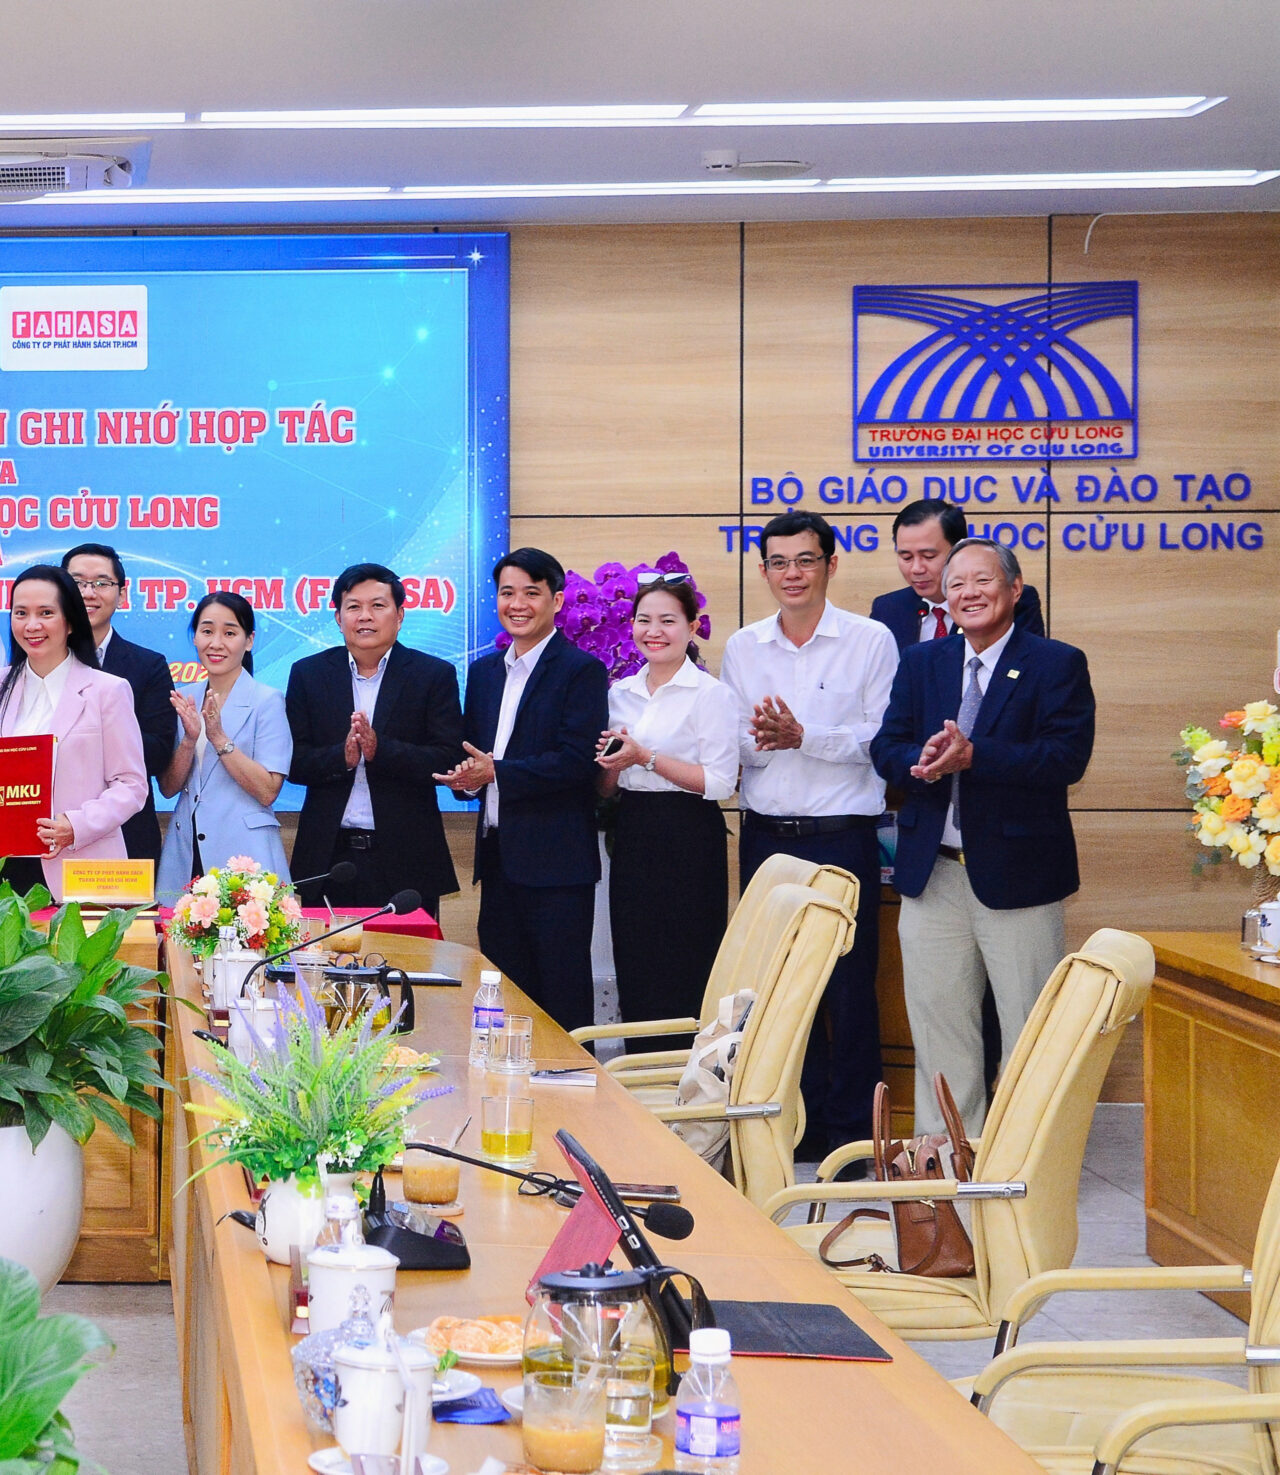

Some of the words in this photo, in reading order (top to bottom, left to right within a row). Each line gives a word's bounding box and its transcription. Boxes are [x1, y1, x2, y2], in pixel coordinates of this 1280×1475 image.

[13, 312, 137, 337] FAHASA
[12, 340, 31, 349] CÔNG
[32, 341, 41, 349] TY
[42, 341, 52, 349] CP
[53, 339, 71, 349] PHÁT
[19, 411, 84, 446] GHI
[97, 402, 180, 445] NHỚ
[189, 409, 267, 452] HỢP
[279, 403, 353, 444] TÁC
[951, 427, 982, 443] ĐẠI
[987, 427, 1024, 443] HỌC
[1075, 425, 1124, 440] LONG
[868, 444, 981, 457] UNIVERSITY
[986, 443, 1015, 456] OF
[1071, 442, 1124, 455] LONG
[751, 471, 804, 514] BỘ
[819, 467, 908, 505] GIÁO
[1011, 467, 1060, 503] VÀ
[1075, 466, 1159, 503] ĐÀO
[1173, 473, 1252, 511] TẠO
[49, 489, 119, 529] CỬU
[129, 497, 219, 529] LONG
[719, 523, 879, 553] TRNG
[1062, 514, 1145, 550] CỬU
[1159, 521, 1264, 551] LONG
[139, 579, 195, 610] TP.
[295, 577, 455, 615] (FSA)
[6, 784, 41, 799] MKU
